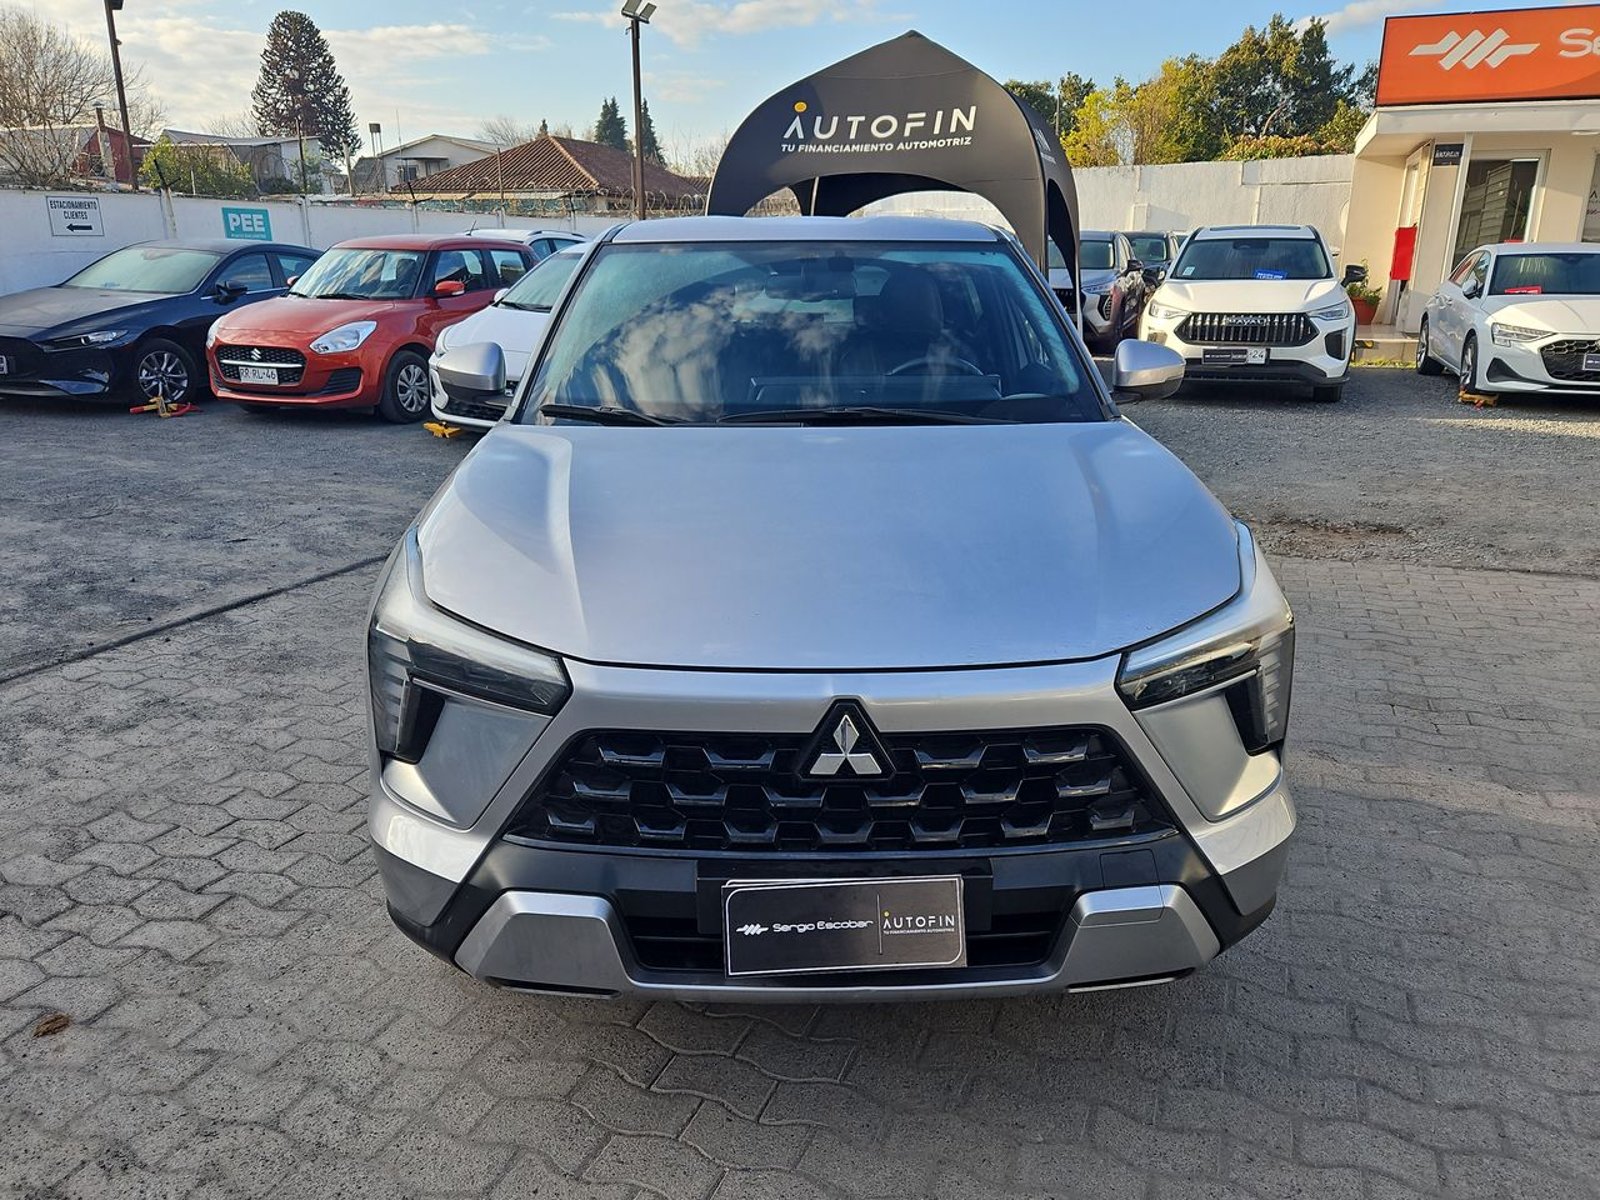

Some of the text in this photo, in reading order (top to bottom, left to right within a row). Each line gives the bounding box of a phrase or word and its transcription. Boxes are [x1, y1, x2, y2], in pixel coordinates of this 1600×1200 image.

[784, 103, 976, 140] AUTOFIN
[781, 137, 972, 153] TU FINANCIAMIENTO AUTOMOTRIZ
[50, 200, 97, 210] ESTACIONAMIENTO
[64, 211, 88, 219] CLIENTES
[228, 213, 265, 231] PEE
[883, 914, 955, 929] AUTOFIN
